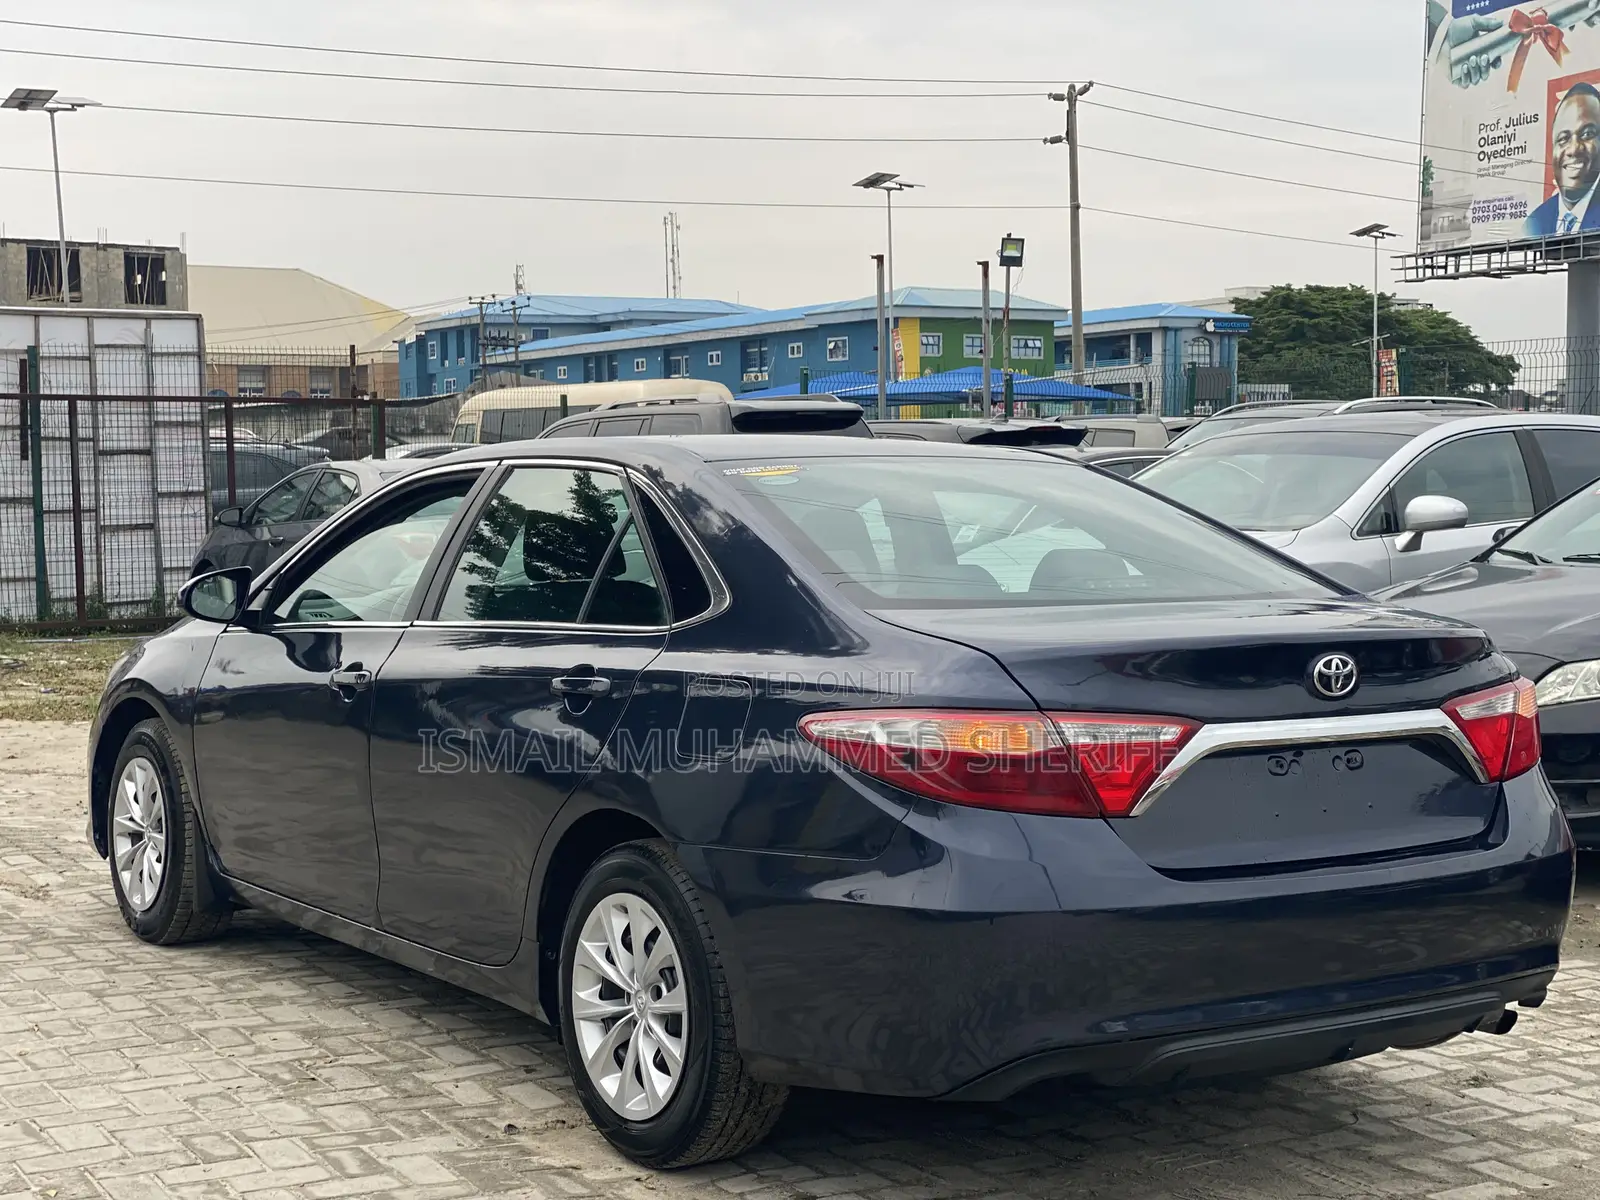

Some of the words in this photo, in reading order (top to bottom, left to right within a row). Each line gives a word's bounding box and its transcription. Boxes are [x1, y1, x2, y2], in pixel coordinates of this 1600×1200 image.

[1478, 118, 1502, 134] Prof.
[1505, 113, 1539, 129] Julius
[1478, 129, 1516, 148] Olaniyi
[1477, 141, 1527, 164] Oyedemi
[1472, 205, 1491, 215] 0703
[1509, 201, 1528, 210] 9696
[1472, 214, 1491, 224] 0909
[1492, 213, 1506, 222] 999
